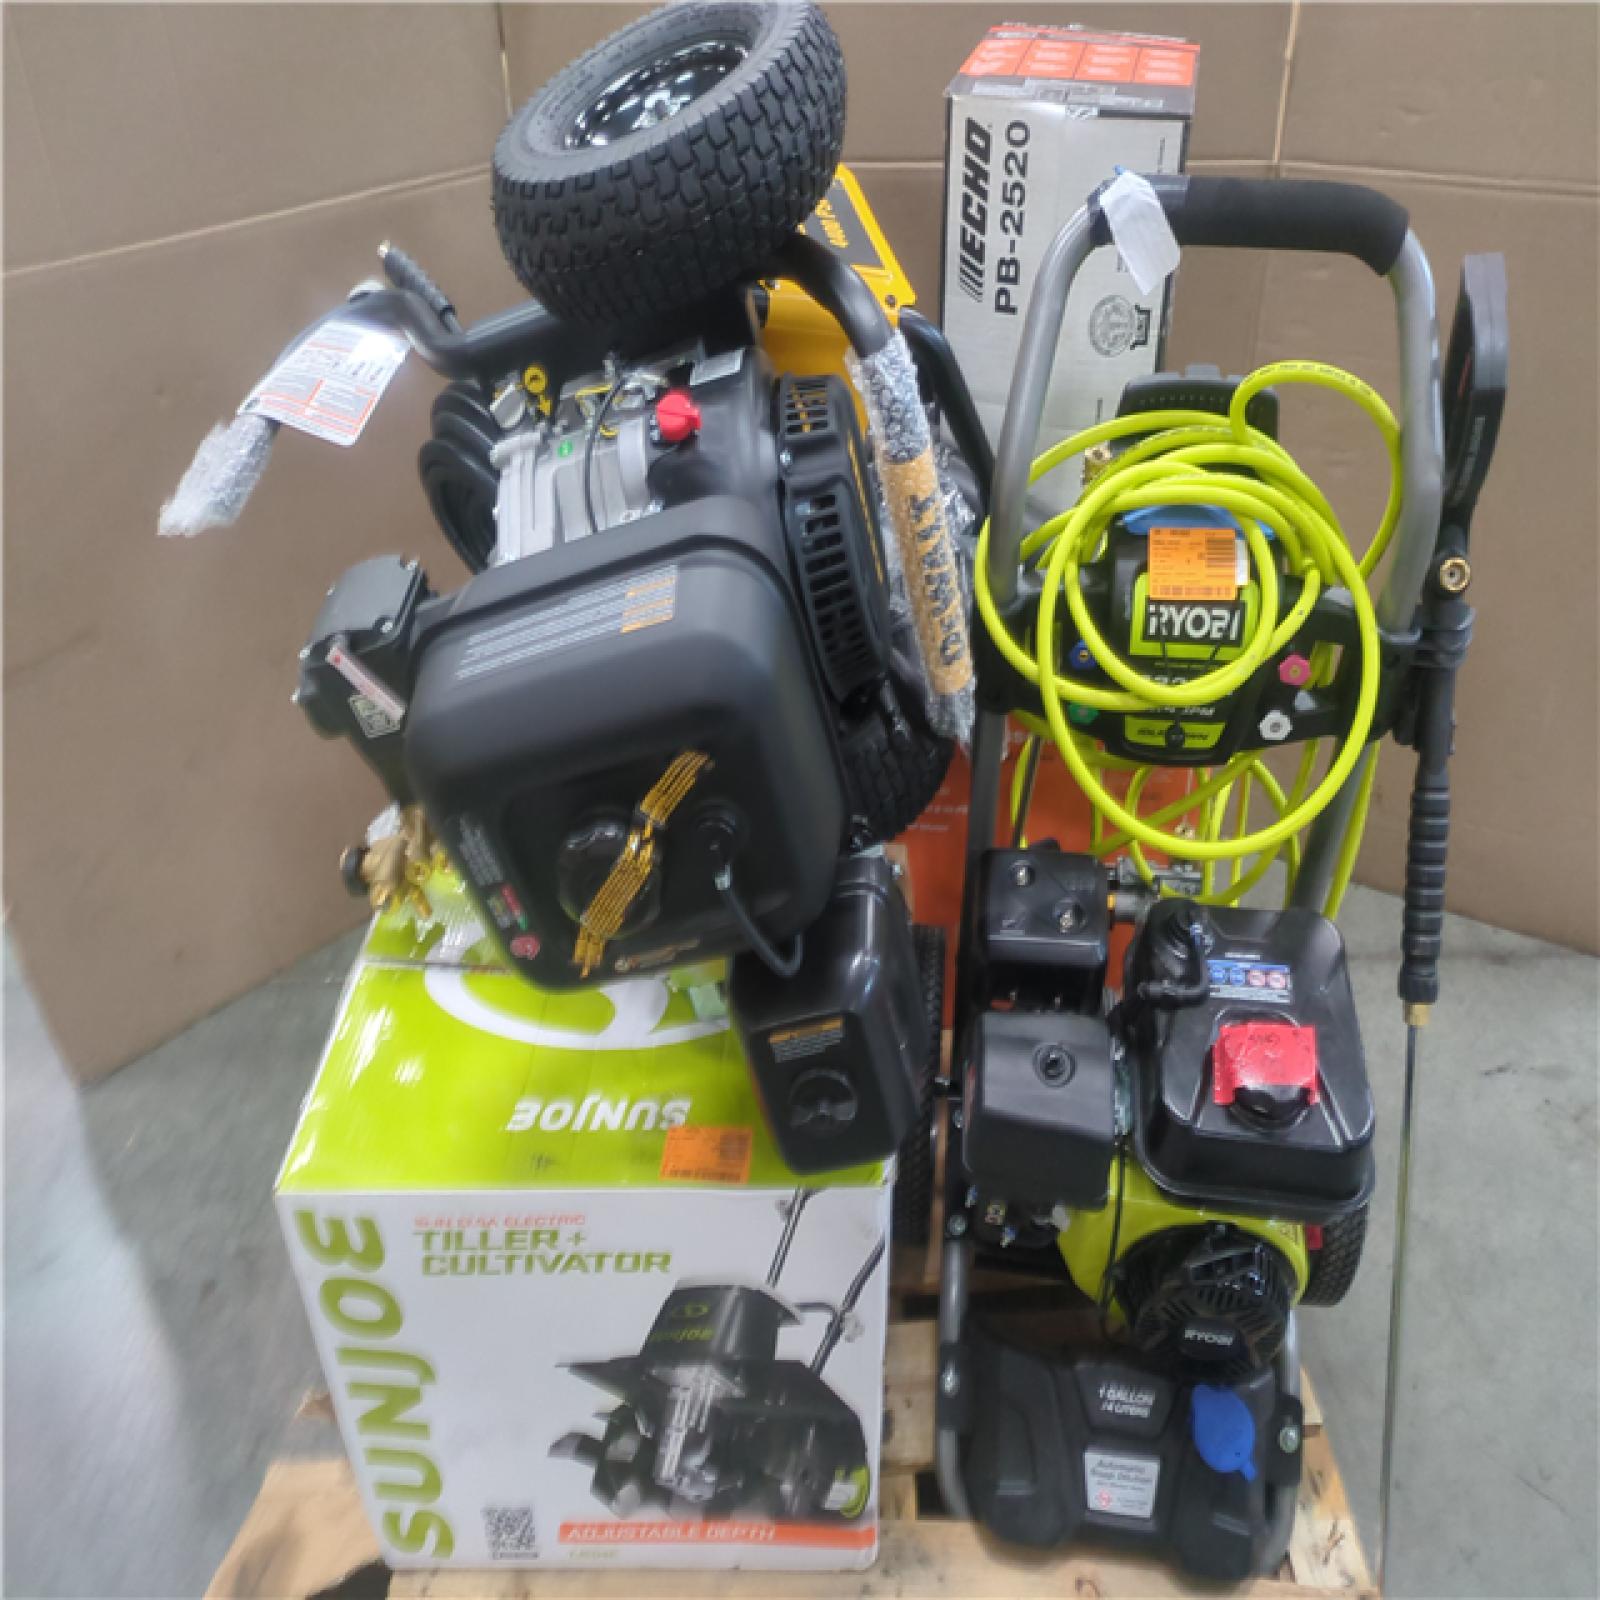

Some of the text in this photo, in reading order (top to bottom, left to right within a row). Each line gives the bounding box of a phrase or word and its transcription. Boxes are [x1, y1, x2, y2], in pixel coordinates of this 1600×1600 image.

[960, 117, 992, 266] ECHO
[994, 119, 1031, 317] PB-2520
[1147, 603, 1242, 642] RYOBI
[504, 1212, 587, 1227] ELECTRIC
[413, 1229, 560, 1251] TILLER
[421, 1250, 672, 1276] CULTIVATOR
[295, 1207, 455, 1560] SUNJOE
[566, 1524, 776, 1541] ADJUSTABLE DEPTH
